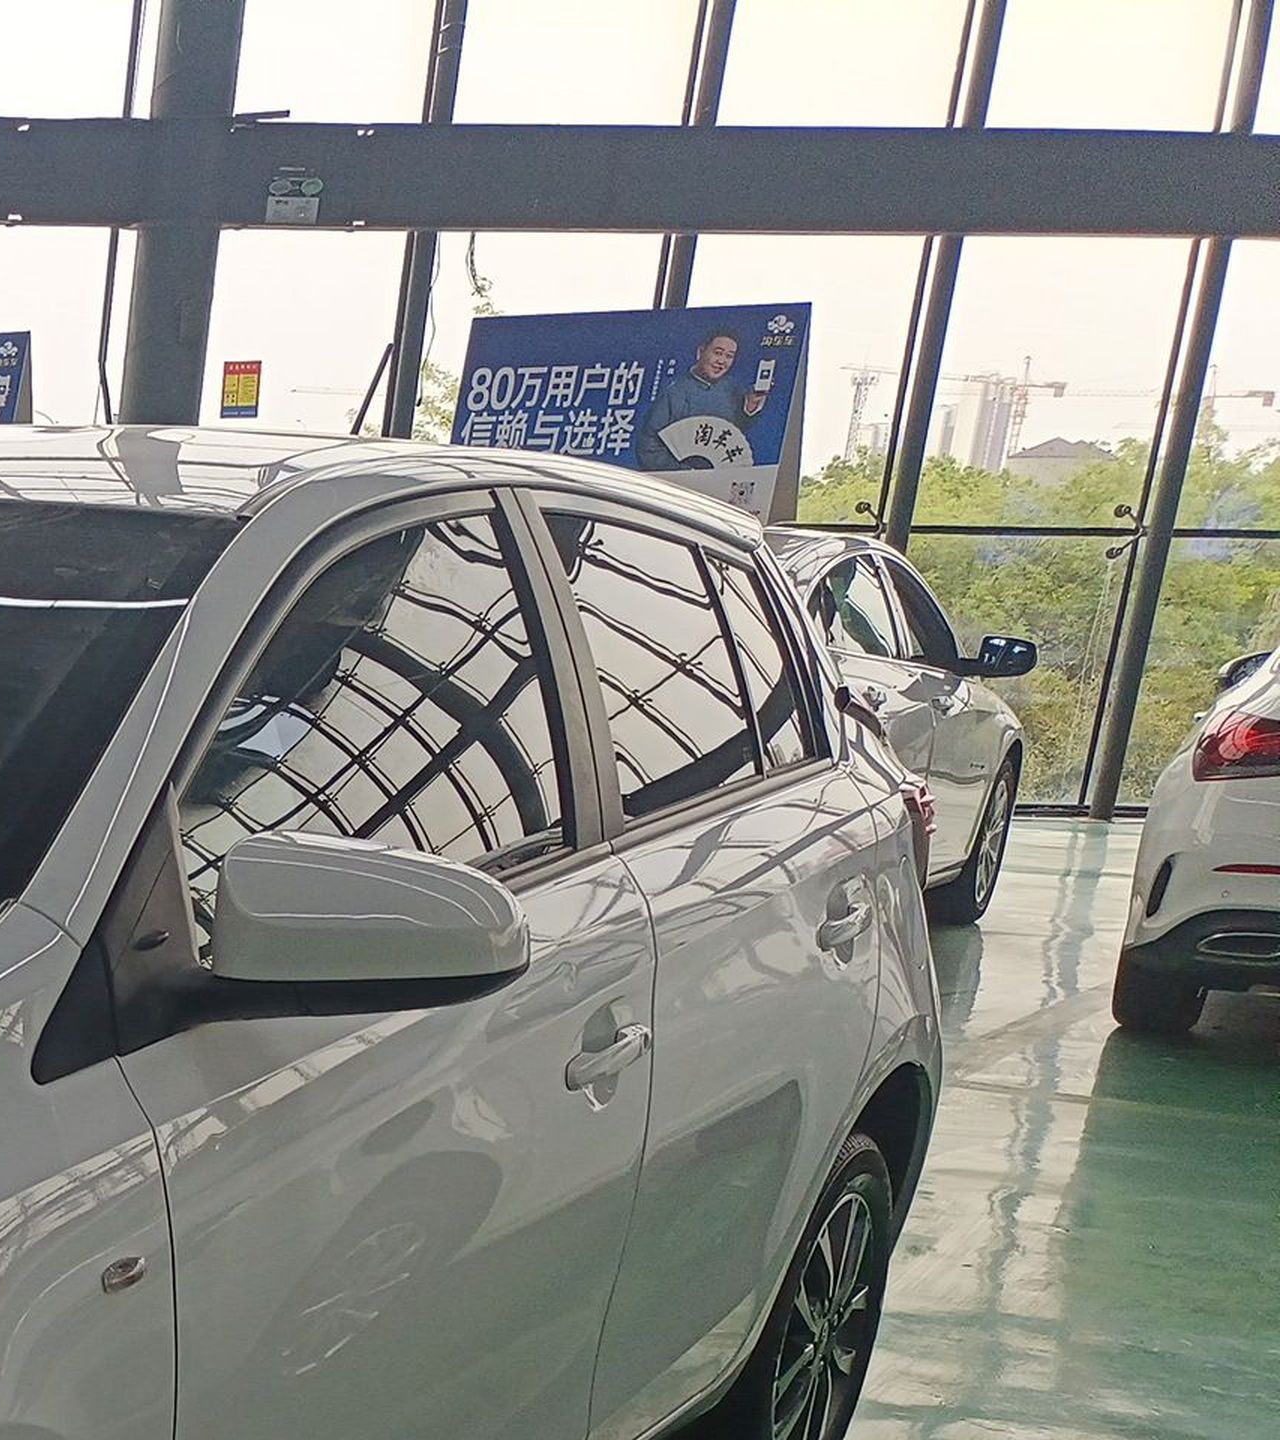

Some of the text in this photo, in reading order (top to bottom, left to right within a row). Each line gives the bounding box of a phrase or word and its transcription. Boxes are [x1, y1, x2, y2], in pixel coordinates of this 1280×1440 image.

[467, 361, 645, 412] 80万用户的
[460, 408, 636, 456] 信赖与选择
